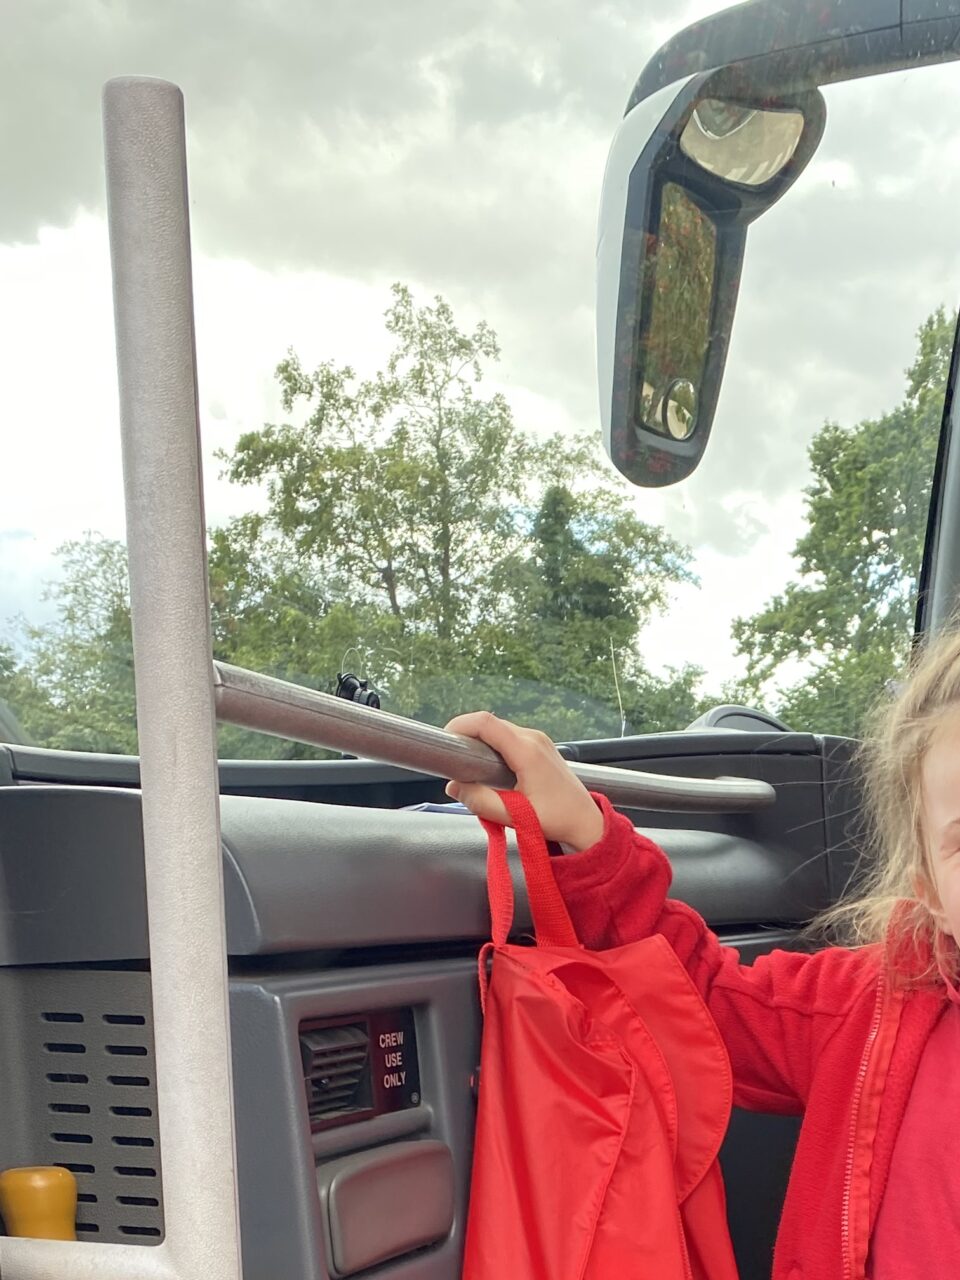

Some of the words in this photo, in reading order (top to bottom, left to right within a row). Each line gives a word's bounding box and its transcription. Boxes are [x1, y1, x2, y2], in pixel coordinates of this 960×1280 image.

[379, 1032, 403, 1048] CREW
[385, 1052, 402, 1067] USE
[383, 1072, 406, 1088] ONLY
